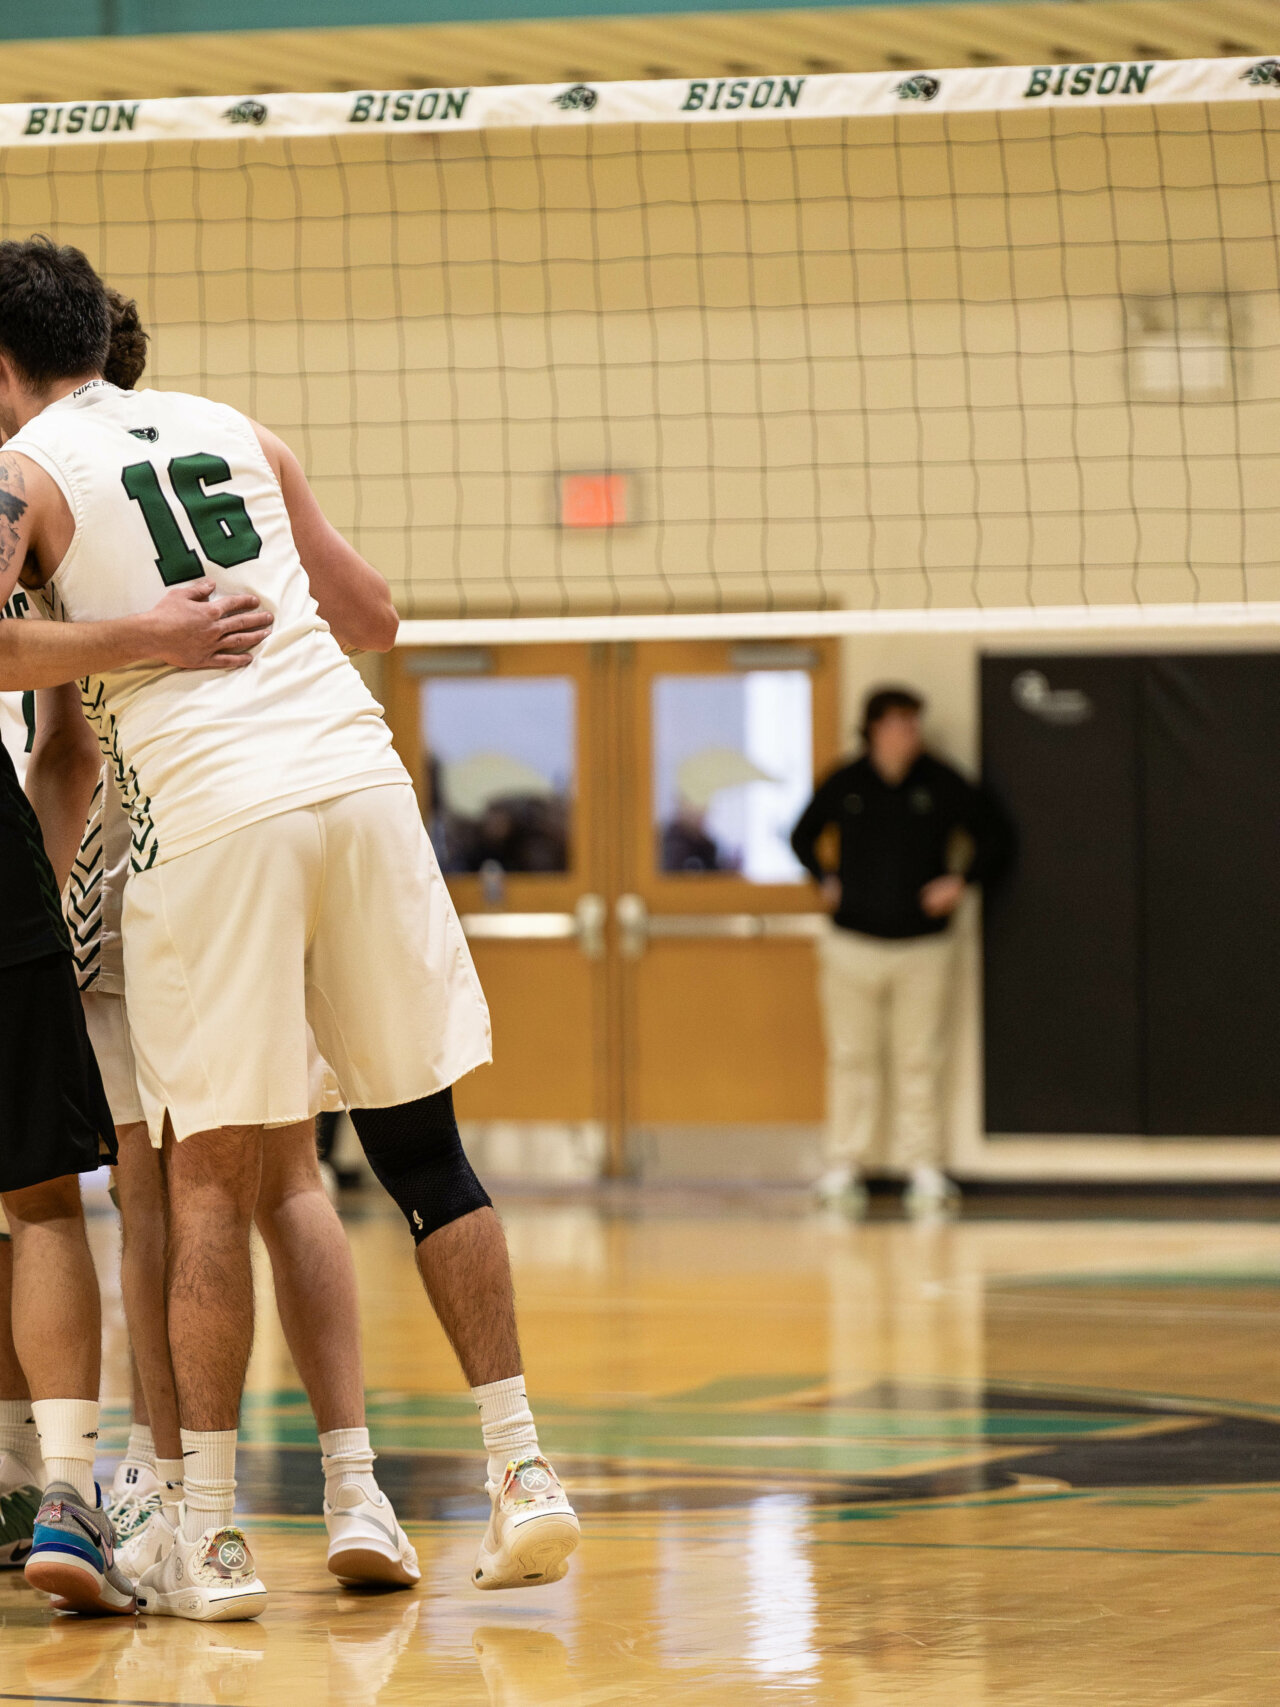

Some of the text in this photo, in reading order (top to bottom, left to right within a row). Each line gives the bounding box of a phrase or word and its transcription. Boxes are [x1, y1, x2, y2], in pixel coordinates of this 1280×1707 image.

[682, 80, 803, 111] BISON
[1024, 66, 1153, 97] BISON
[24, 104, 138, 134] BISON
[350, 92, 470, 122] BISON
[73, 381, 101, 399] NIKE
[121, 453, 264, 587] 16
